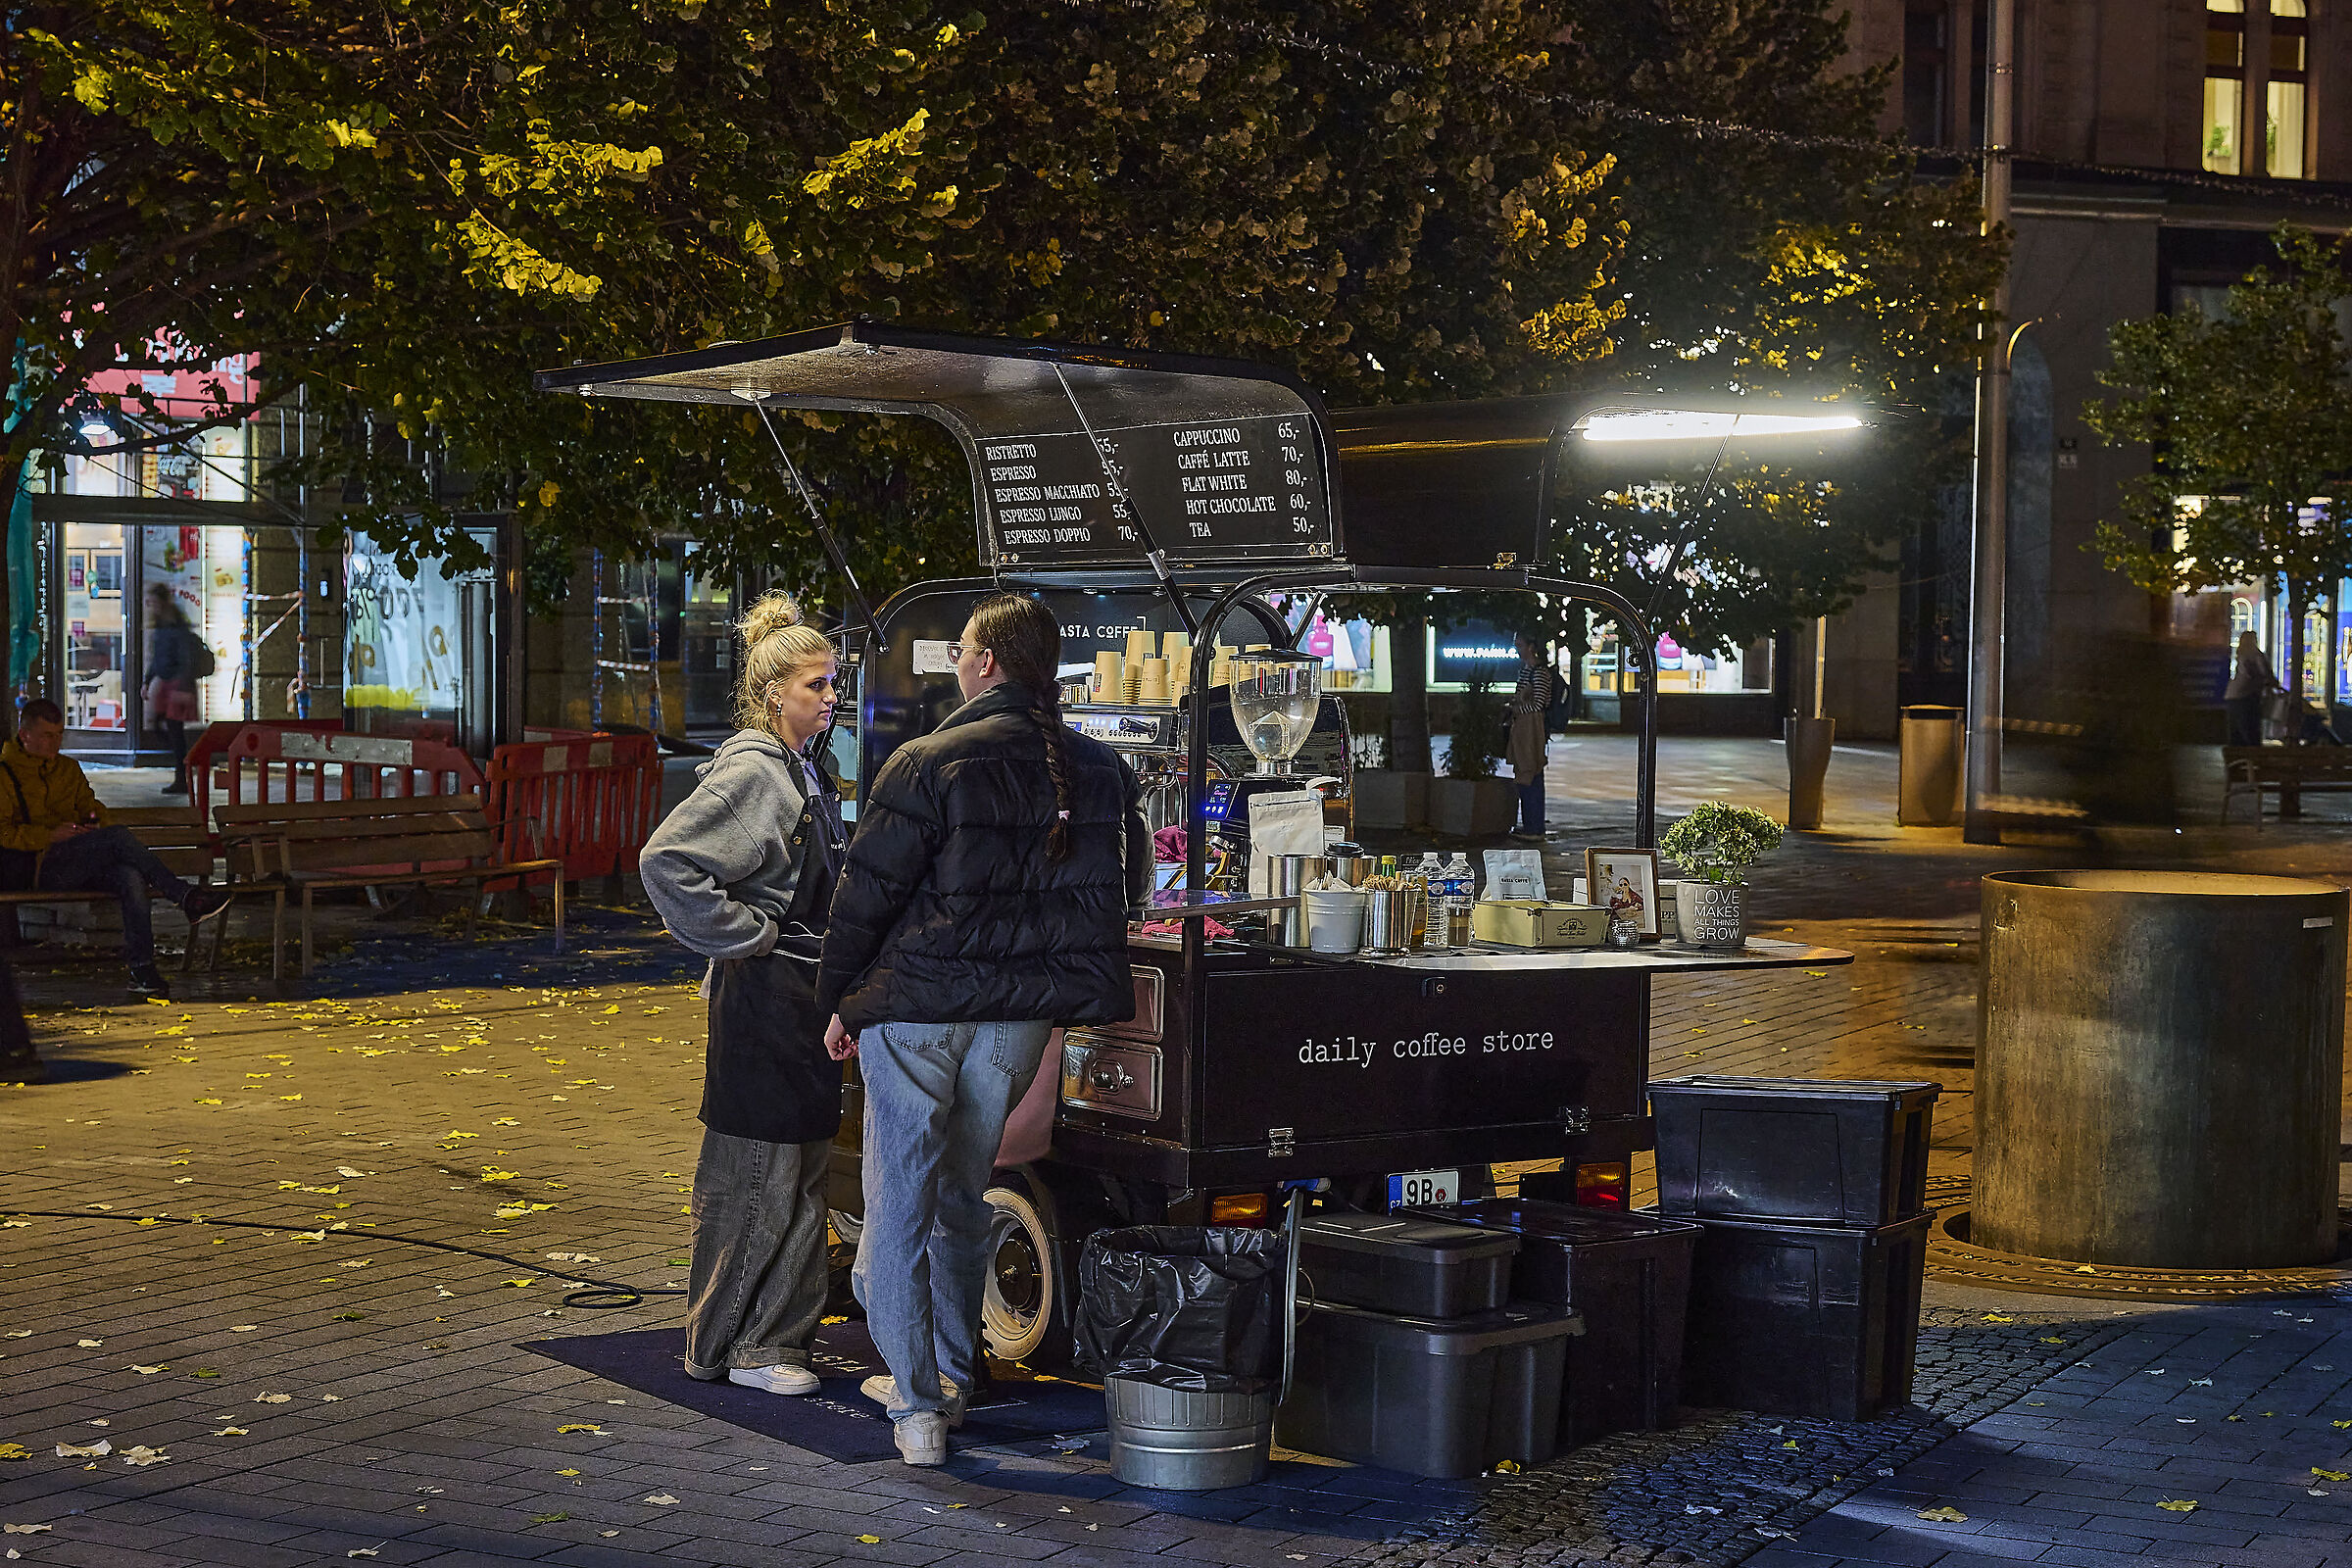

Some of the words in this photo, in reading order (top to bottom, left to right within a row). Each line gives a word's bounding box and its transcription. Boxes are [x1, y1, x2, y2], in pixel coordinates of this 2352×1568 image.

[1173, 427, 1241, 447] CAPPUCCINO
[1278, 421, 1300, 441] 65,-
[985, 443, 1037, 462] RISTRETTO
[1177, 449, 1210, 470] CAFFÉ
[1212, 450, 1250, 468] LATTE
[1281, 446, 1304, 465] 70,-
[990, 465, 1037, 482] ESPRESSO
[1181, 476, 1207, 492] FLAT
[1207, 473, 1248, 491] WHITE
[1286, 468, 1308, 488] 80,-
[994, 486, 1042, 503] ESPRESSO
[1043, 483, 1101, 501] MACCHIATO
[1186, 499, 1208, 515] HOT
[1209, 495, 1277, 514] CHOCOLATE
[1290, 493, 1312, 512] 60,-
[1000, 508, 1047, 524] ESPRESSO
[1049, 506, 1082, 521] LUNGO
[1004, 528, 1051, 545] ESPRESSO
[1054, 527, 1091, 543] DOPPIO
[1117, 525, 1139, 541] 70,-
[1189, 521, 1212, 538] TEA
[1292, 516, 1315, 534] 50,-
[1059, 624, 1091, 638] ASTA
[1693, 889, 1740, 905] LOVE
[1694, 906, 1740, 918] MAKES
[1693, 927, 1740, 941] GROW
[1298, 1036, 1376, 1069] daily
[1393, 1032, 1466, 1058] coffee
[1482, 1029, 1554, 1054] store
[1406, 1178, 1434, 1205] 9B
